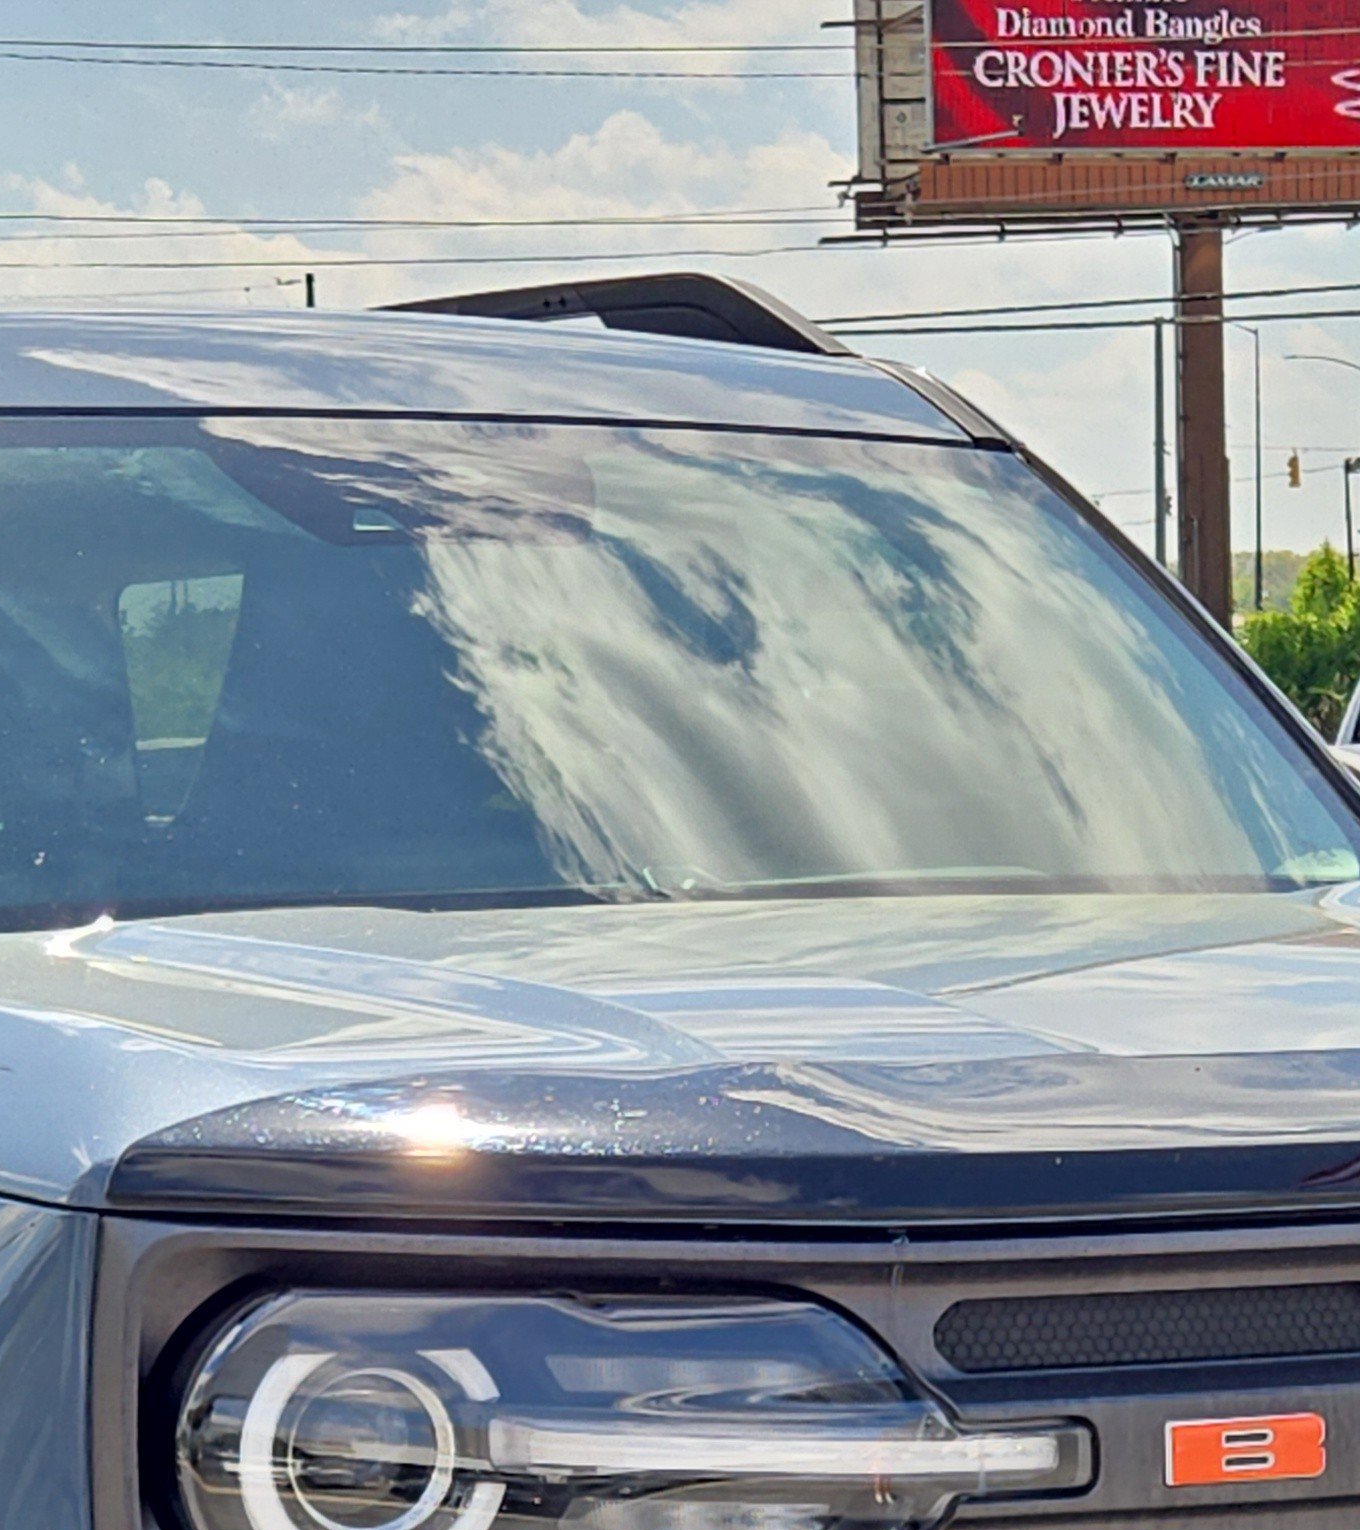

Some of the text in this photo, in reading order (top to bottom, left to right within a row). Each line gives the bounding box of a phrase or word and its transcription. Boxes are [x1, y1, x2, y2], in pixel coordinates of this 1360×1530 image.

[996, 8, 1262, 44] Diamond Bangles
[973, 48, 1286, 88] CRONIER'S FINE
[1052, 91, 1222, 139] JEWELRY
